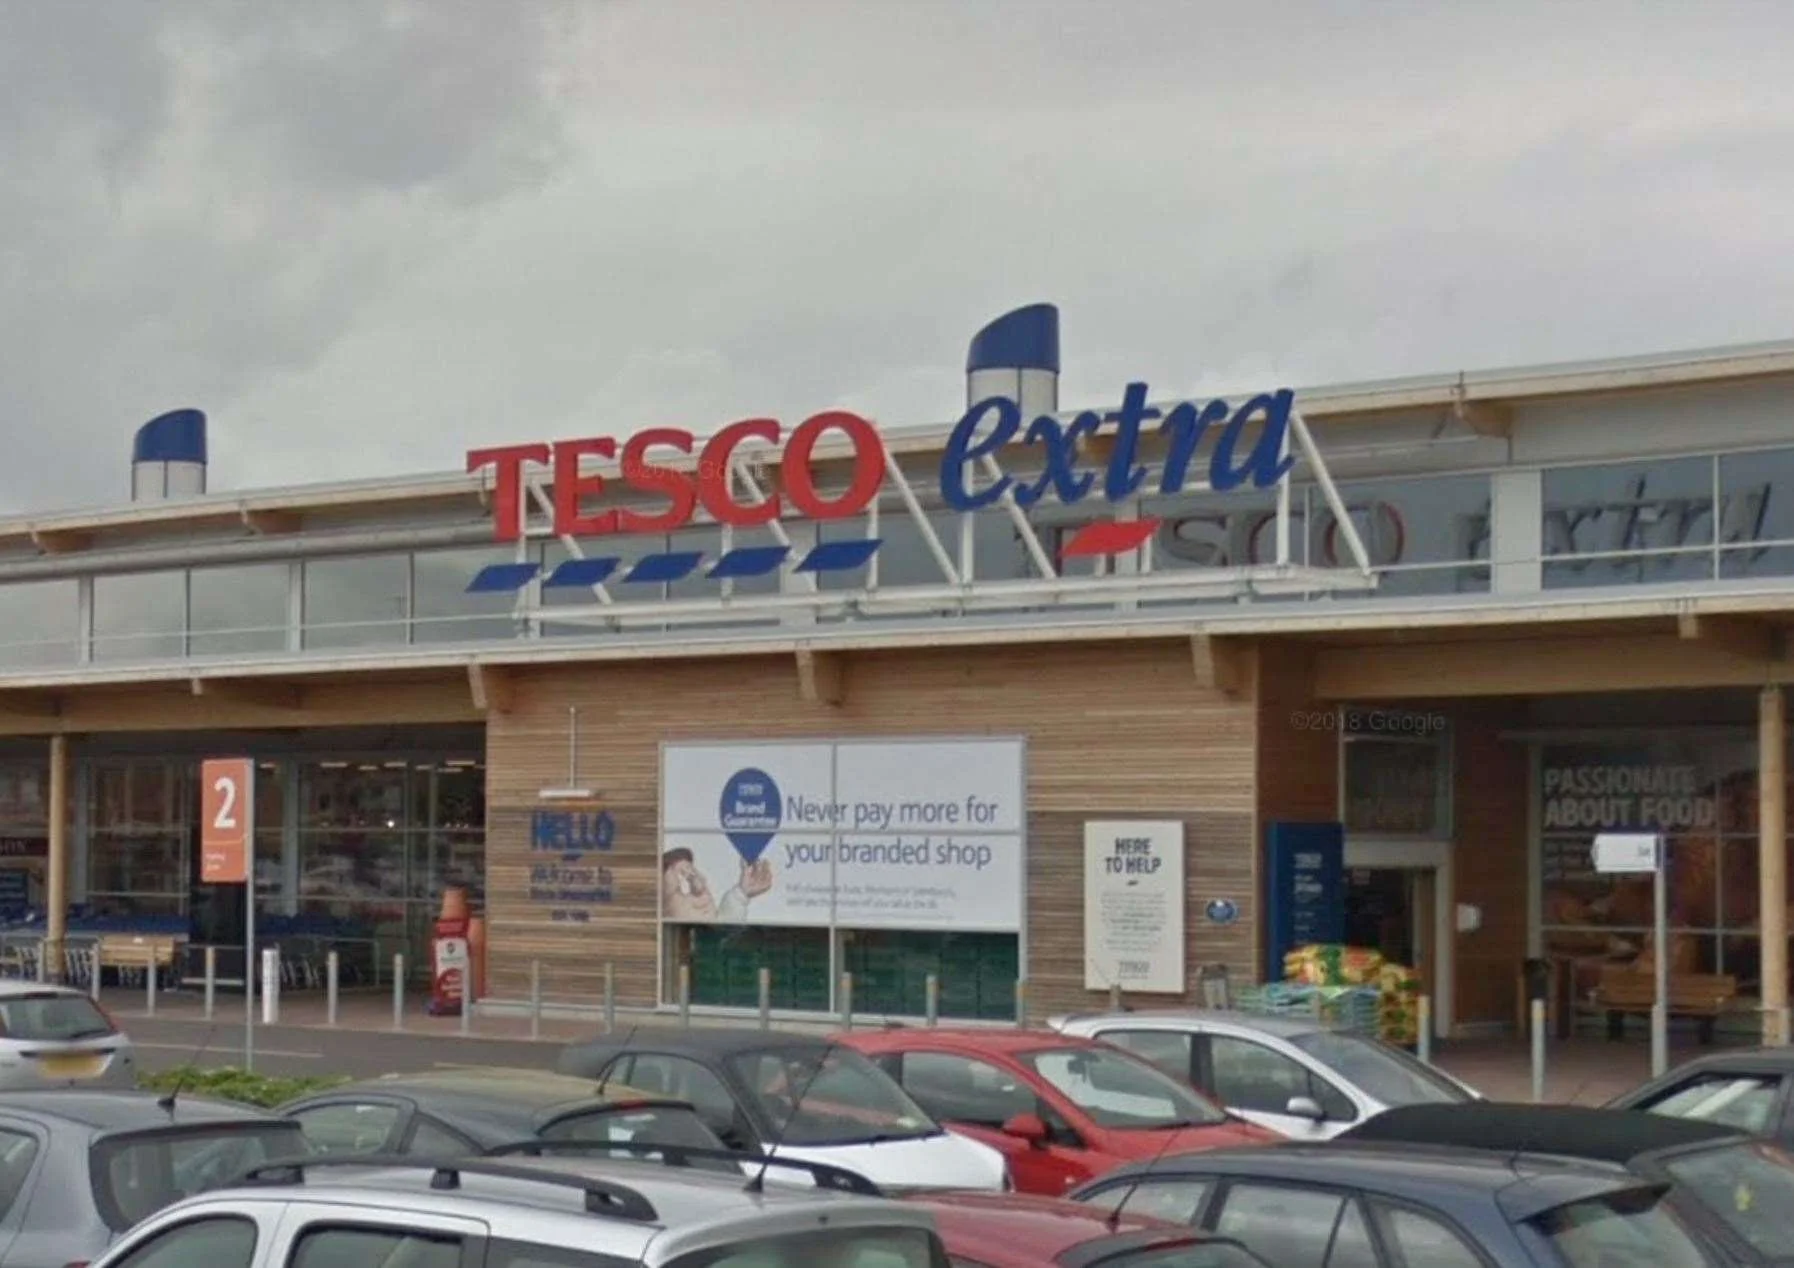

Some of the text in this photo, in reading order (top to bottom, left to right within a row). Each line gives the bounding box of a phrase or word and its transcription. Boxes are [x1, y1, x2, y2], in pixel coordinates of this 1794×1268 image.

[467, 381, 1295, 541] TESCO extra
[1544, 766, 1696, 794] PASSIONATE
[214, 777, 236, 828] 2
[786, 796, 998, 829] Never pay more for
[1544, 797, 1716, 828] ABOUT FOOD
[785, 837, 992, 870] your branded shop
[1115, 837, 1151, 855] HERE
[1105, 856, 1162, 874] TO HELP
